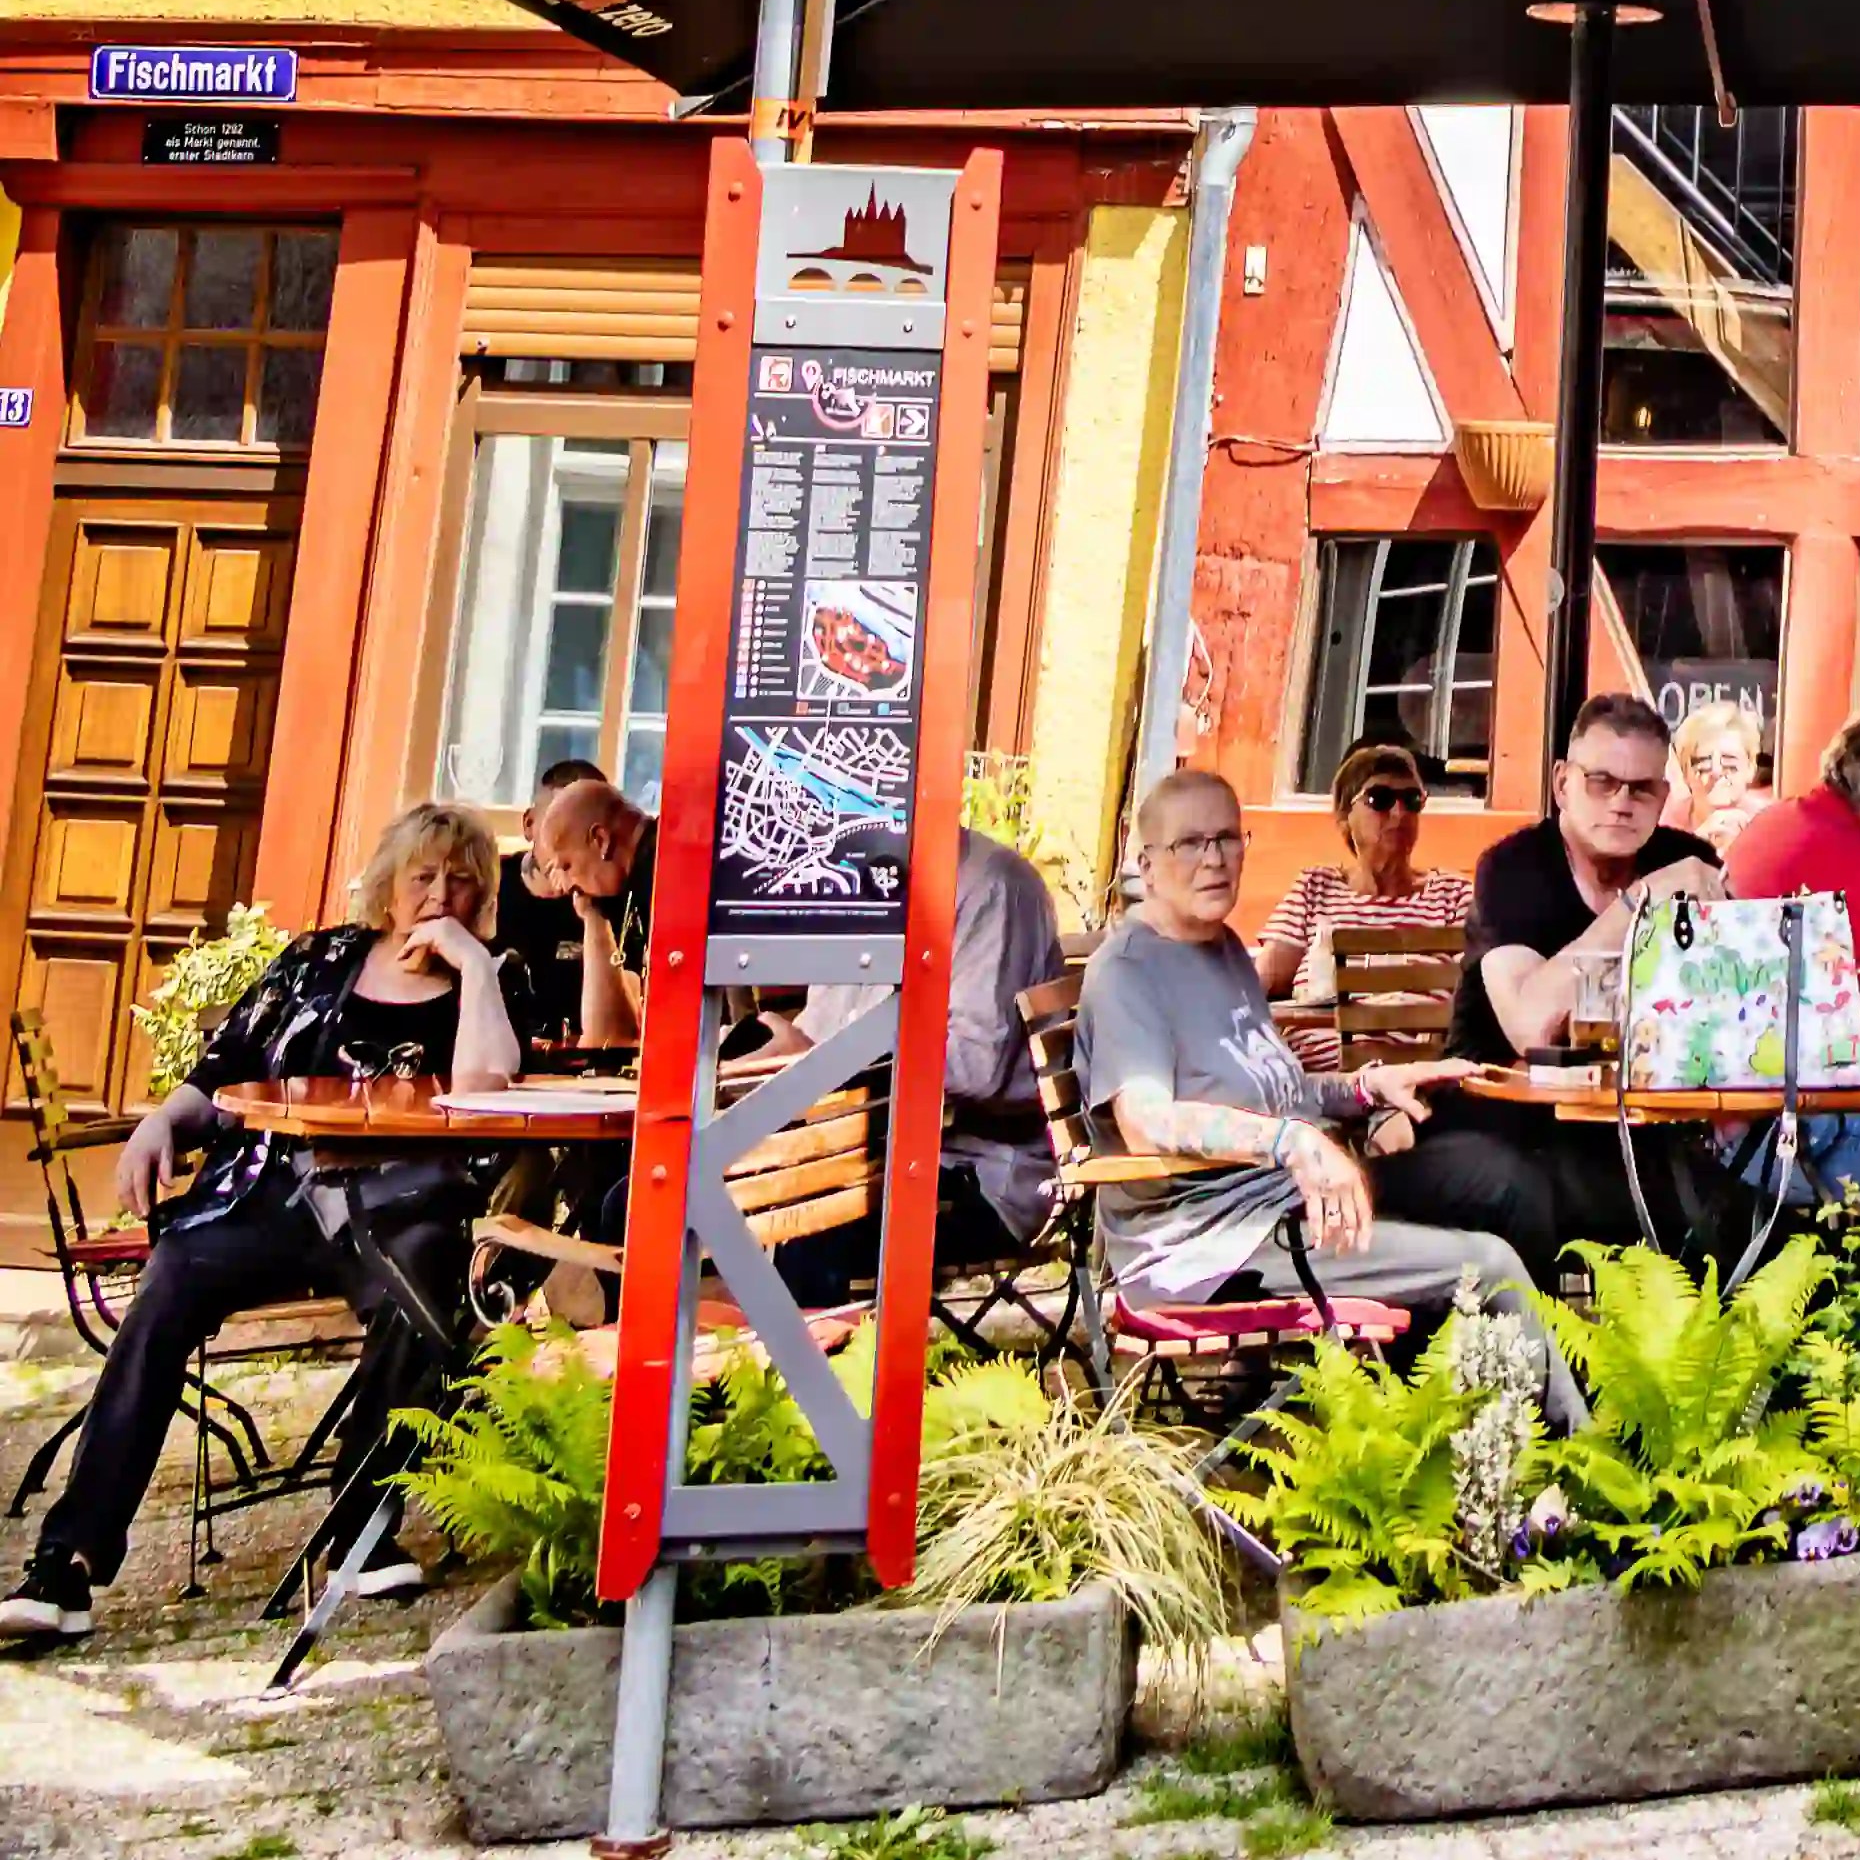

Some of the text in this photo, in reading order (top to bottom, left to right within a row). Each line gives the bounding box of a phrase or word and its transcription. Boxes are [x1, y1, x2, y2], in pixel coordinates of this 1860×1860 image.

[597, 3, 674, 39] zero
[108, 51, 278, 93] Fischmarkt
[832, 366, 936, 389] FISCHMARKT
